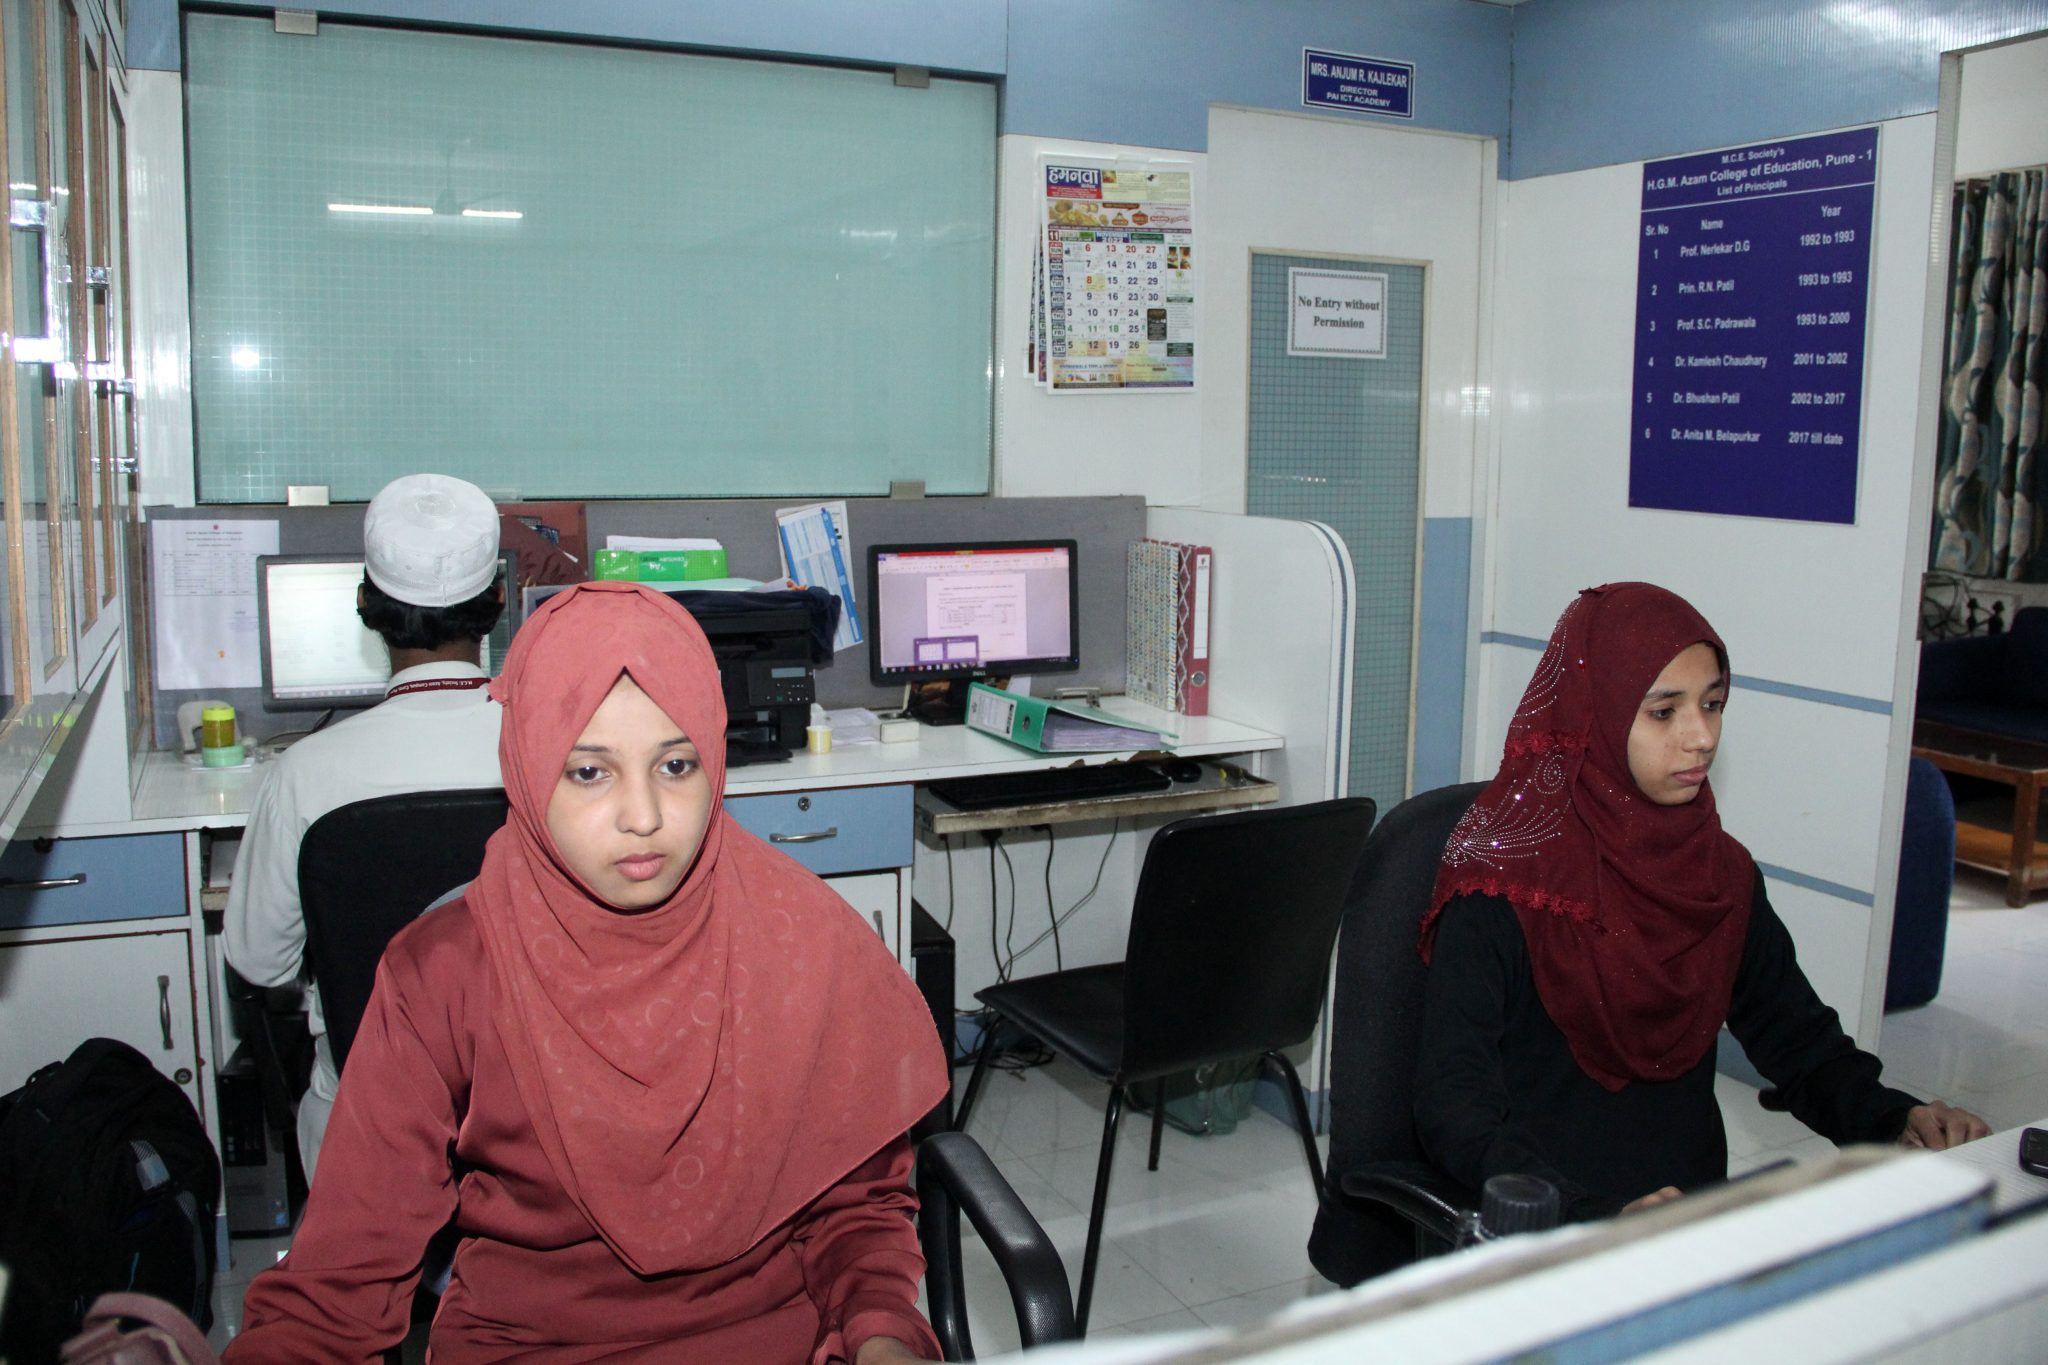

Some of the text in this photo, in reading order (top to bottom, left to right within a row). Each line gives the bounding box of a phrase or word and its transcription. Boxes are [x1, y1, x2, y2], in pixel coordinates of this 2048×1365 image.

[1311, 62, 1407, 88] MRS. ANJUM R. KAJLEKAR
[1340, 85, 1378, 96] DIRECTOR
[1327, 92, 1390, 107] PAI ICT ACADEMY
[1722, 147, 1784, 164] M.C.E. Society's
[1048, 168, 1098, 185] हमनवा
[1647, 178, 1678, 190] H.G.M.
[1680, 173, 1707, 187] Azam
[1710, 167, 1747, 182] College
[1750, 164, 1762, 177] of
[1764, 157, 1822, 174] Education,
[1826, 153, 1856, 166] Pune
[1866, 149, 1872, 160] 1
[1717, 178, 1788, 196] List of Principals
[1646, 205, 1842, 236] Sr. No Name Year
[1049, 232, 1058, 240] 11
[1085, 244, 1091, 252] 6
[1654, 249, 1658, 259] 1
[1680, 245, 1699, 257] Prof.
[1735, 240, 1750, 252] D.G
[1800, 233, 1820, 246] 1992
[1822, 233, 1832, 244] to
[1834, 230, 1855, 243] 1993
[1086, 260, 1091, 268] 7
[1087, 276, 1092, 284] 8
[1128, 277, 1138, 285] 22
[1652, 270, 1852, 295] 2 Prin. R.N. Patil 1993 to 1993
[1148, 293, 1158, 301] 30
[1298, 296, 1380, 311] No Entry without
[1128, 325, 1139, 333] 25
[1314, 316, 1364, 328] Permission
[1650, 321, 1655, 331] 3
[1677, 319, 1695, 331] Prof.
[1697, 319, 1713, 329] S.C.
[1796, 313, 1816, 326] 1993
[1818, 314, 1827, 324] to
[1829, 312, 1850, 324] 2000
[1088, 341, 1099, 349] 12
[1129, 341, 1139, 349] 26
[1648, 352, 1848, 368] 4 Dr. Kamlesh Chaudhary 2001 to 2002
[1647, 392, 1845, 404] 5 Dr. Bhushan Patil 2002 to 2017
[1645, 428, 1650, 438] 6
[1671, 428, 1682, 440] Dr.
[1705, 429, 1714, 440] M.
[1716, 430, 1760, 443] Belapurkar
[1788, 431, 1809, 444] 2017
[1810, 432, 1822, 444] till
[1824, 433, 1844, 444] date
